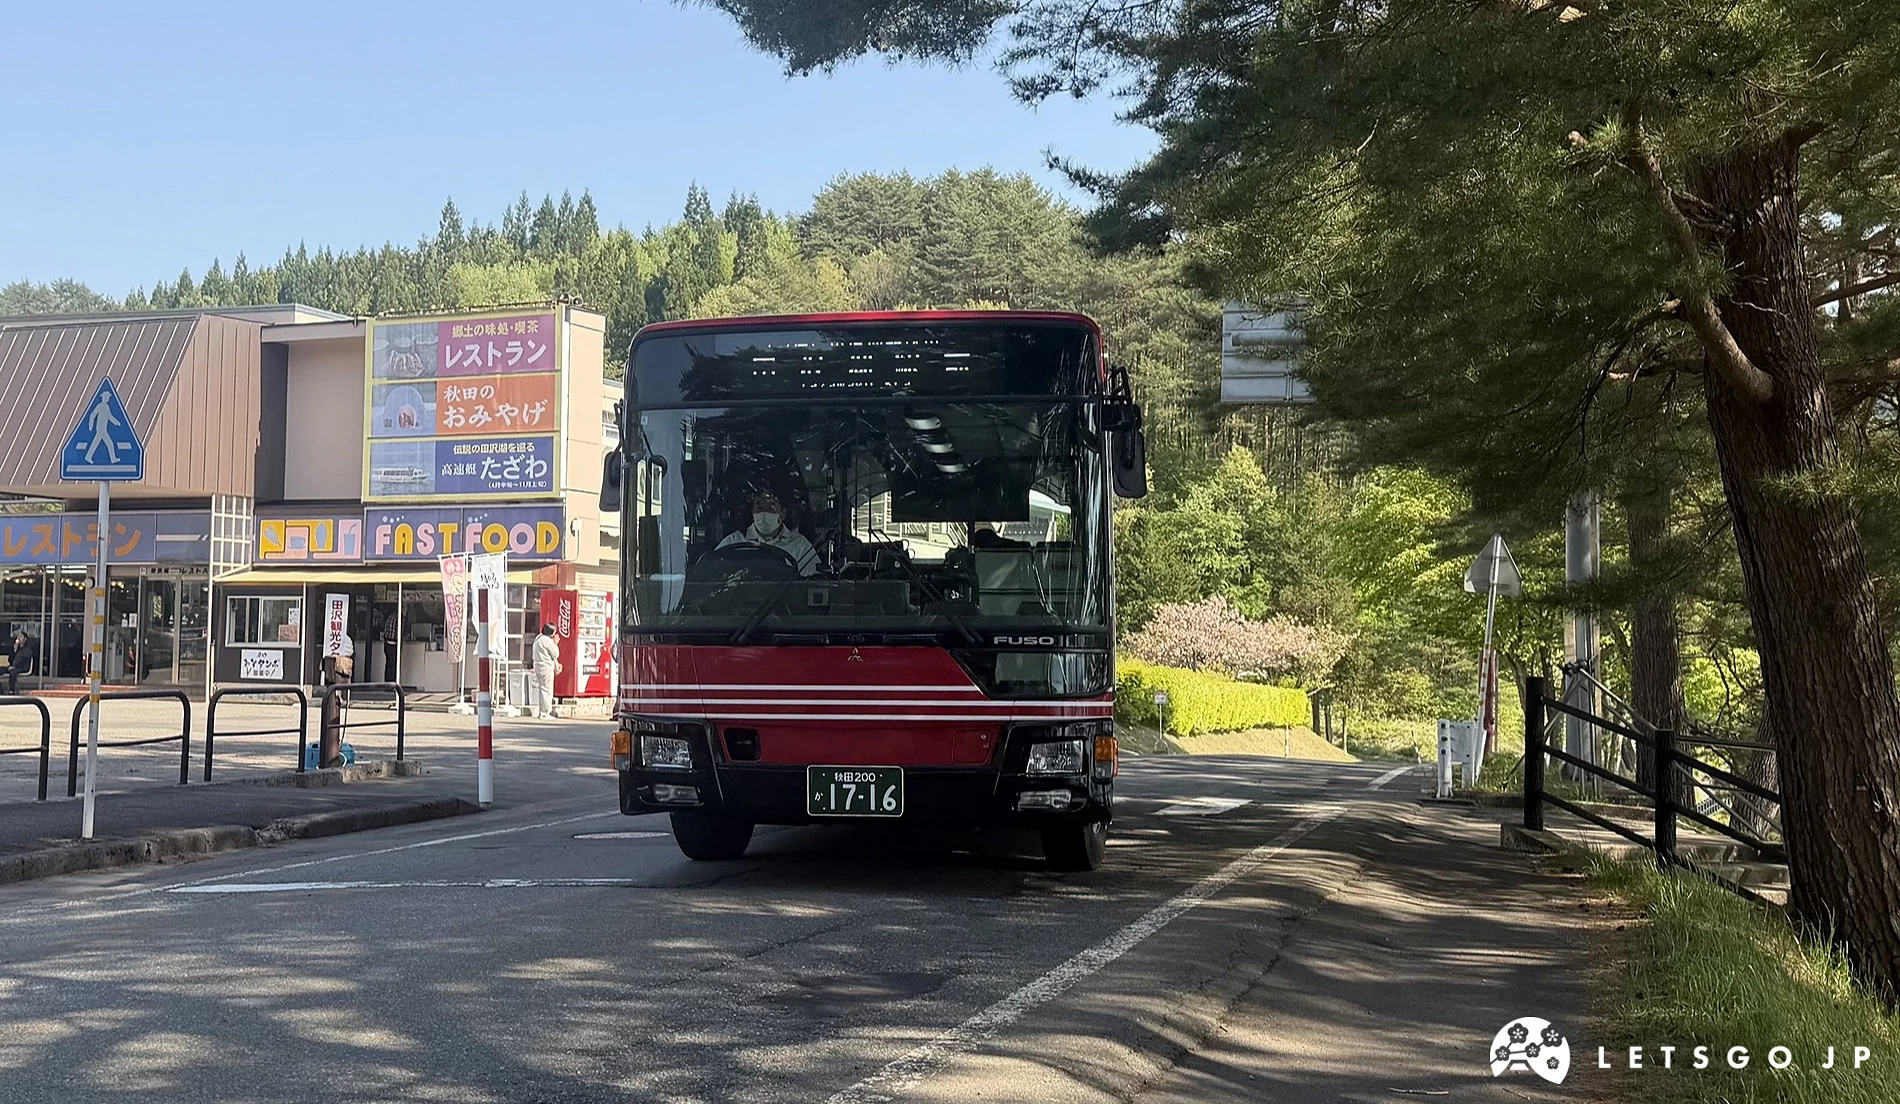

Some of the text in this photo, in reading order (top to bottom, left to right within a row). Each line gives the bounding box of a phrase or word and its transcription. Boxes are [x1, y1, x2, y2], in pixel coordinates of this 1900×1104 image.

[452, 320, 539, 338] 郷土の味処・喫茶
[445, 339, 547, 369] レストラン
[443, 384, 495, 402] 秋田の
[442, 399, 548, 429] おみやげ
[453, 442, 536, 456] 伝説の田沢湖を巡る
[375, 520, 560, 556] FAST FOOD
[330, 600, 343, 656] 田沢観光タ
[993, 636, 1055, 645] FUSO
[834, 771, 876, 783] 秋田200
[814, 783, 897, 811] か 17-16
